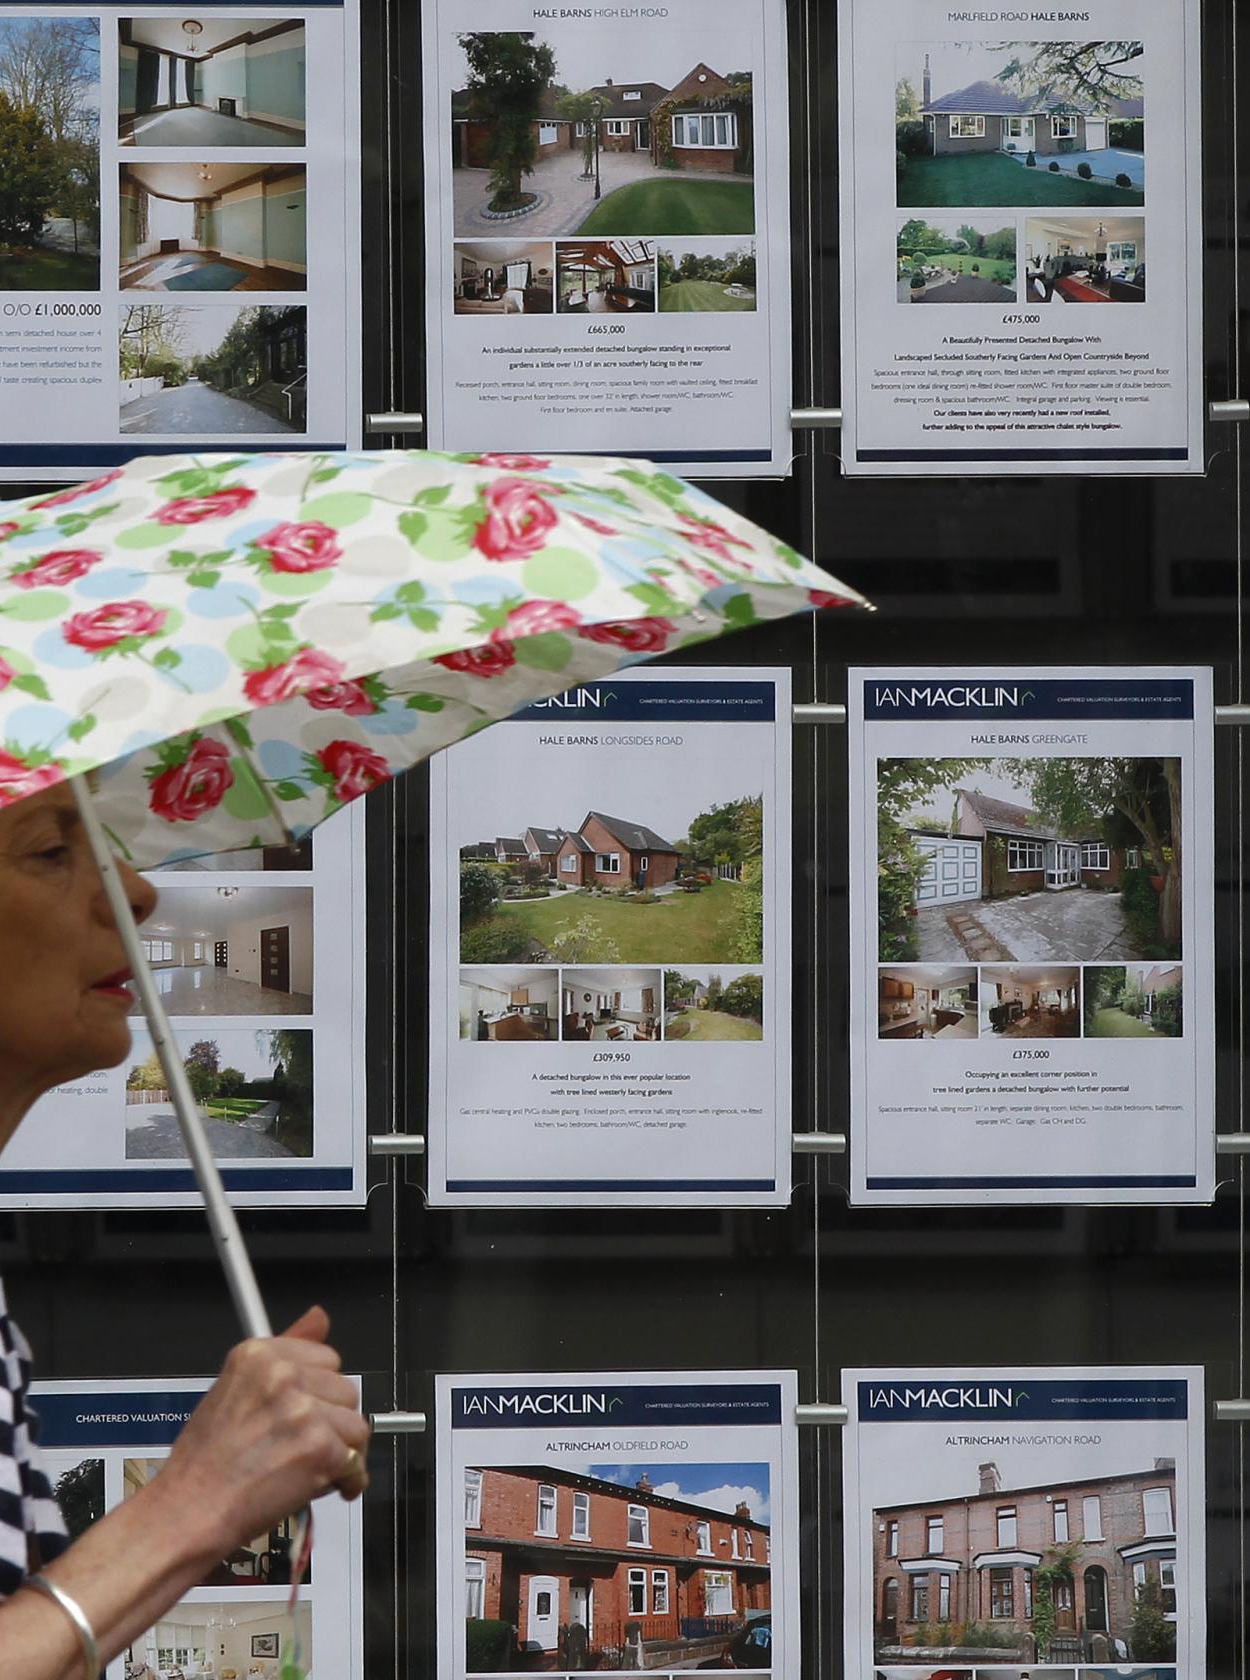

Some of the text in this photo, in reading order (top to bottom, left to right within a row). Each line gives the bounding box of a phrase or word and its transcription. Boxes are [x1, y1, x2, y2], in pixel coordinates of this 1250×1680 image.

[533, 8, 669, 18] HALE BARNS HIGH ELM ROAD
[948, 12, 1090, 21] MARLFIELD ROAD HALE BARNS
[3, 303, 102, 317] O/O £1,000,000
[1002, 315, 1040, 324] £475,000
[587, 325, 625, 335] £665,000
[539, 736, 683, 745] HALE BARNS LONGSIDES ROAD
[971, 734, 1088, 744] HALE BARNS GREENGATE
[593, 1053, 631, 1062] £309,950
[1012, 1050, 1050, 1059] £375,000
[76, 1414, 129, 1423] CHARTERED
[130, 1413, 182, 1422] VALUATION
[945, 1435, 1102, 1445] ALTRINCHAM NAVIGATION ROAD
[545, 1440, 689, 1451] ALTRINCHAM OLDFIELD ROAD
